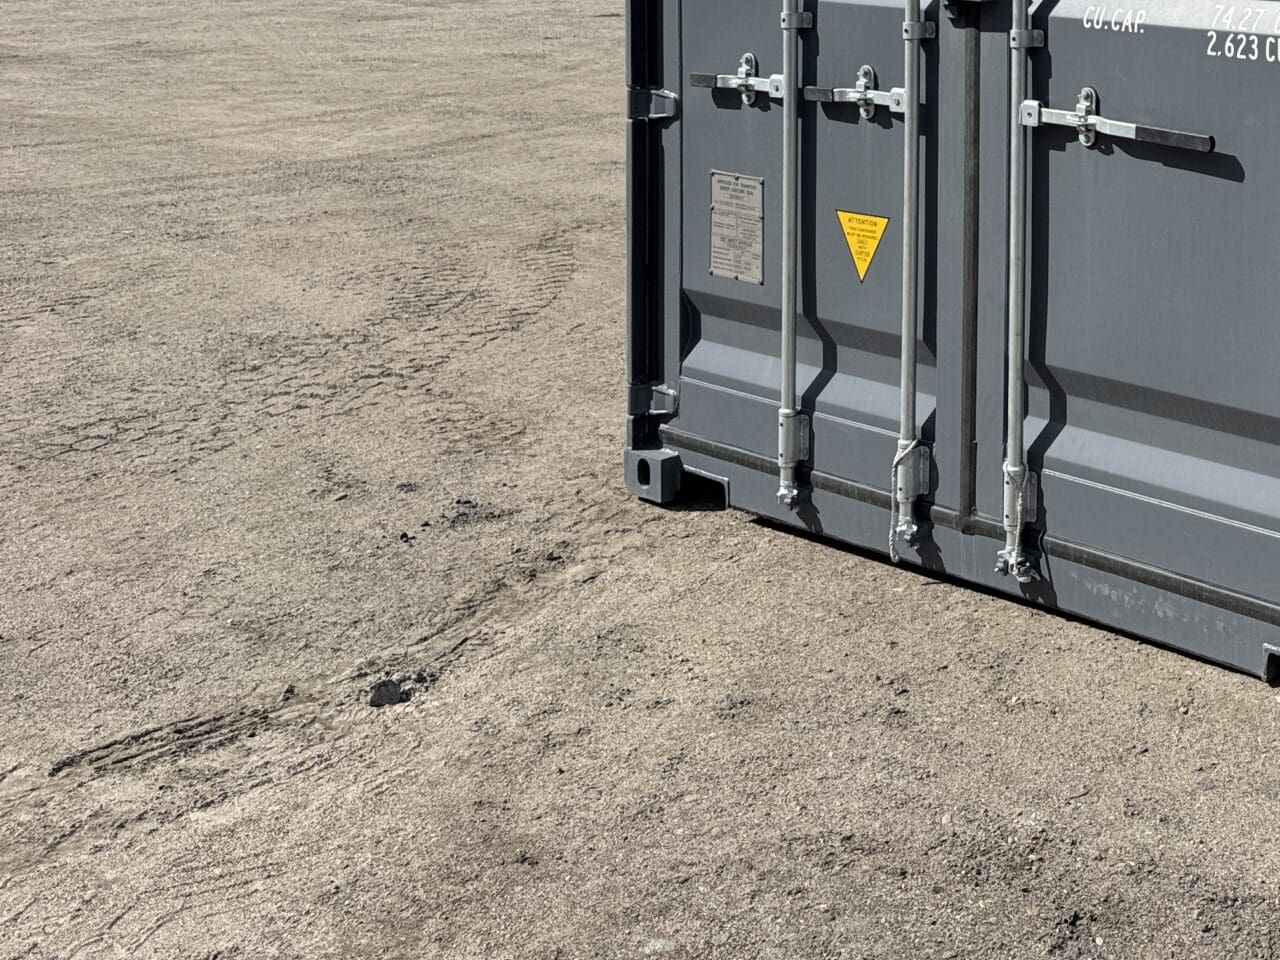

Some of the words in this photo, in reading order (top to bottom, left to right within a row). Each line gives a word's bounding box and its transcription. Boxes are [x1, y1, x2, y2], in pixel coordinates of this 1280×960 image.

[1082, 5, 1146, 34] CU.CAP.
[1206, 30, 1259, 60] 2,623
[847, 217, 878, 227] ATTENTION
